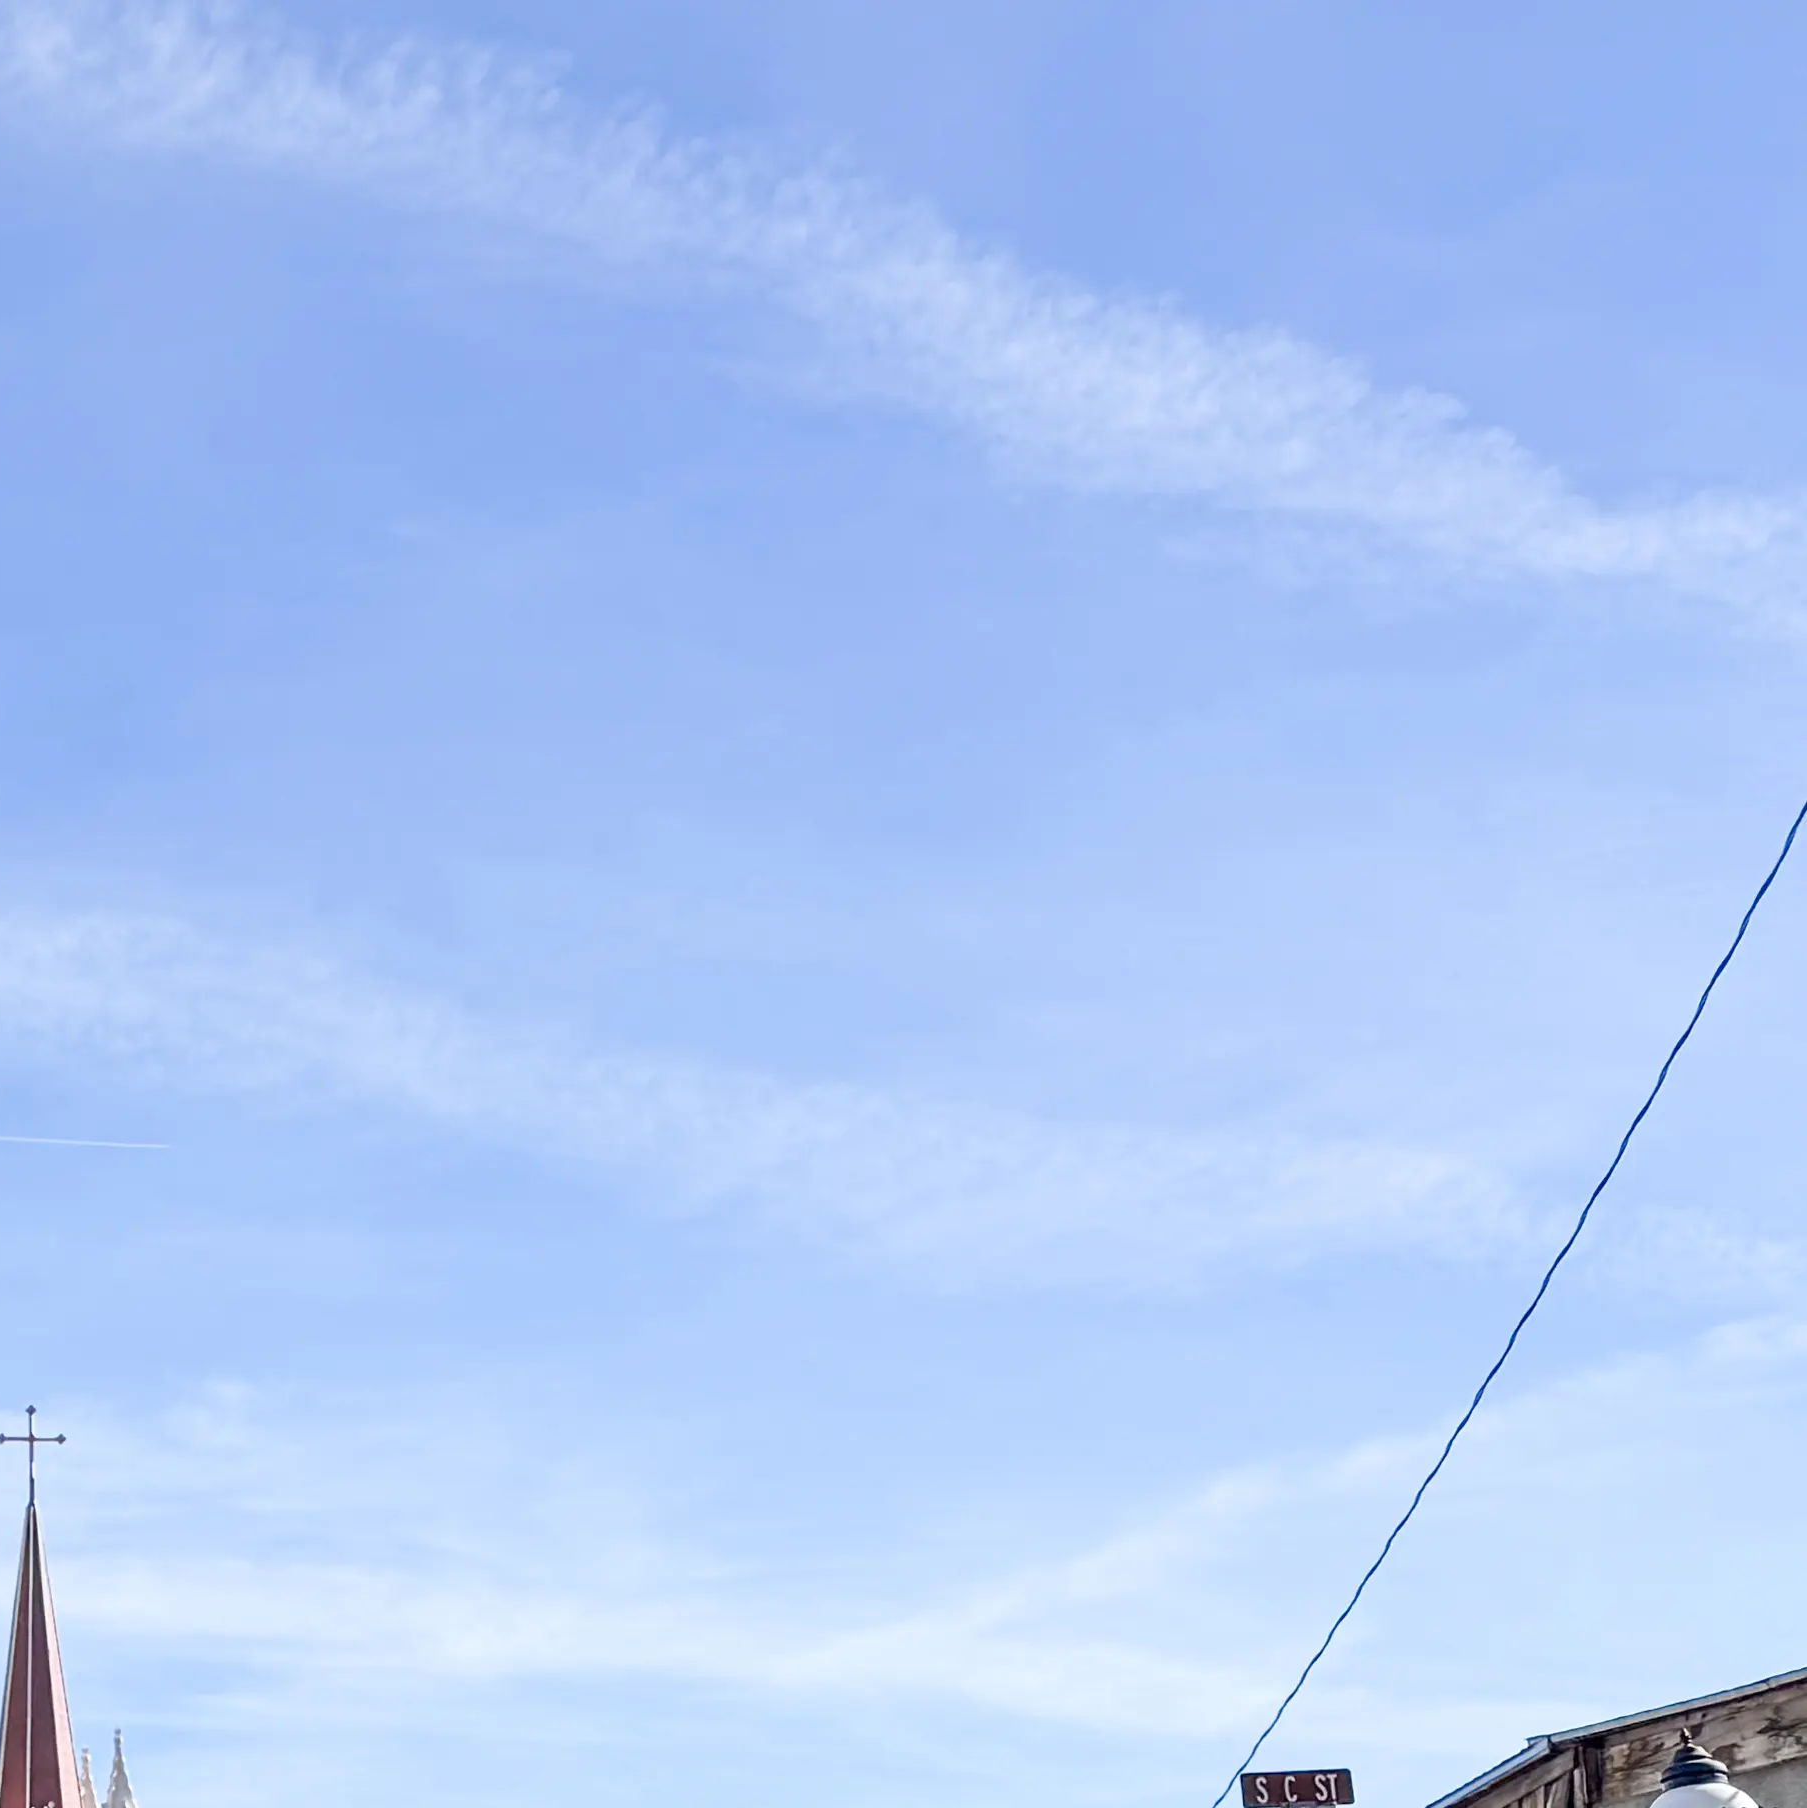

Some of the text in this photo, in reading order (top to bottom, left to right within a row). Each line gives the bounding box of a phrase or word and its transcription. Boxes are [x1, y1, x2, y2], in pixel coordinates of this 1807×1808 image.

[1255, 1774, 1338, 1803] S C ST
